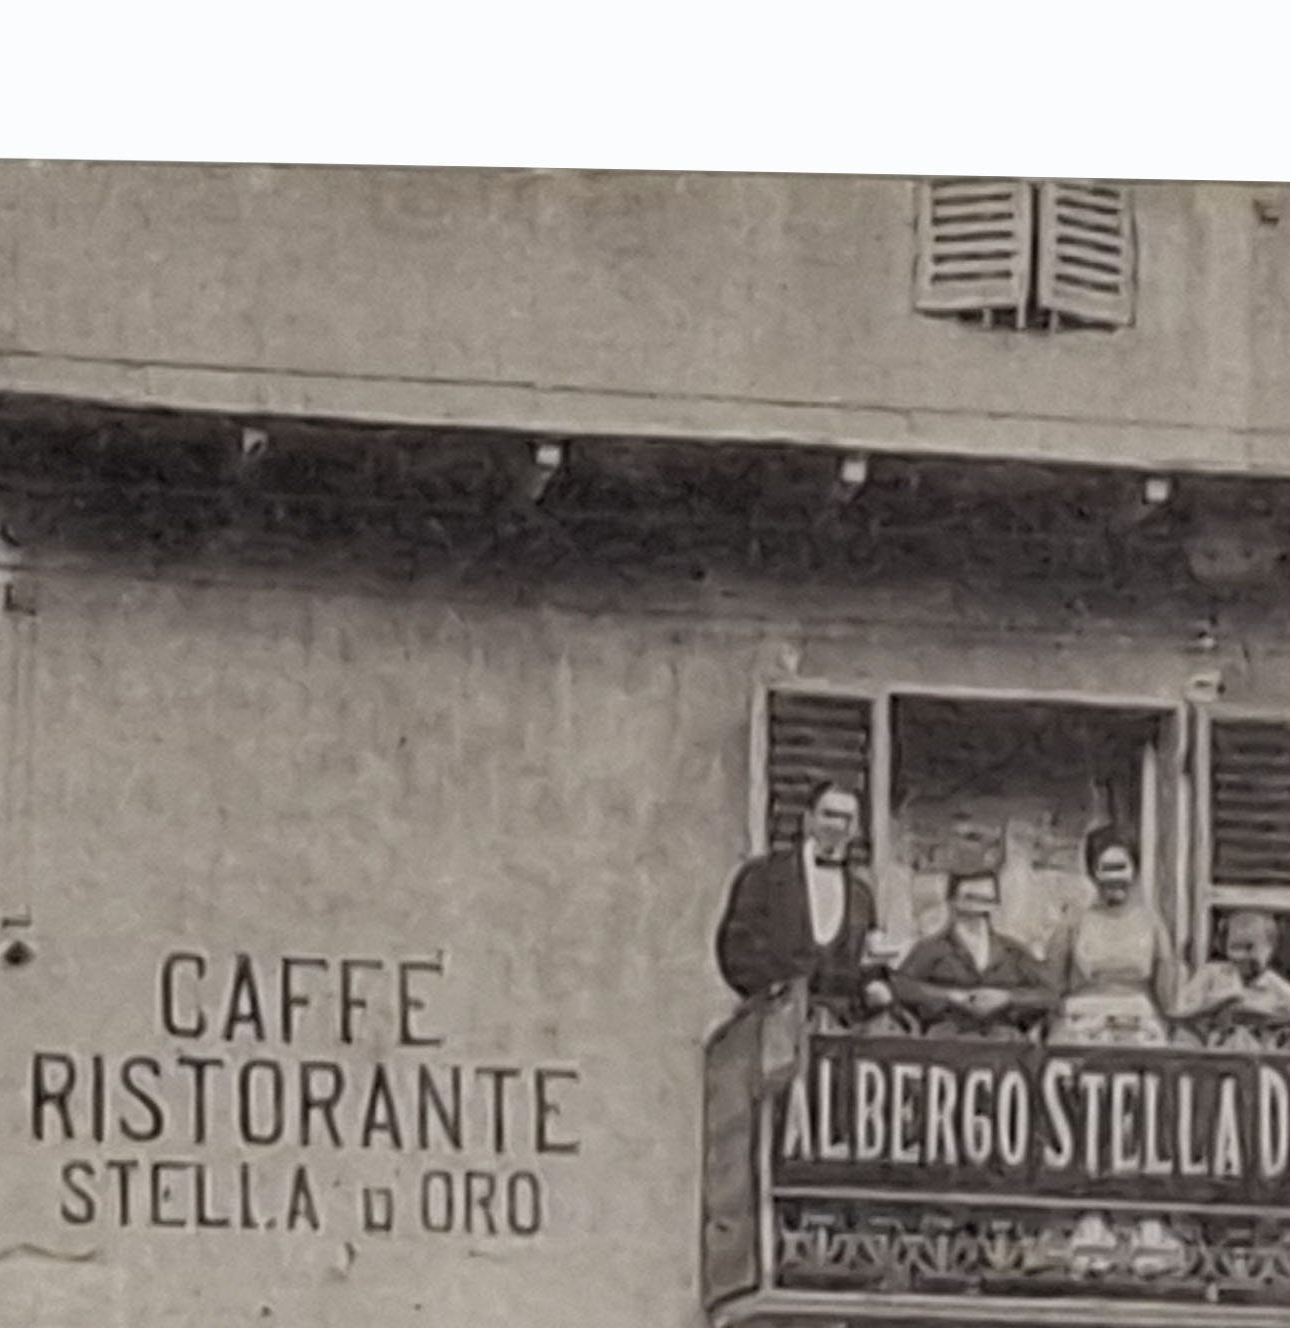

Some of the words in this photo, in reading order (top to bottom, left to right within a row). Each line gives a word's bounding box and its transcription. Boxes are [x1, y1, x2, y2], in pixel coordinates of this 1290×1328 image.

[32, 1052, 581, 1155] RISTORANTE
[783, 1057, 1031, 1165] ALBERGO
[1042, 1061, 1243, 1177] STELLA
[60, 1159, 321, 1231] STELLA
